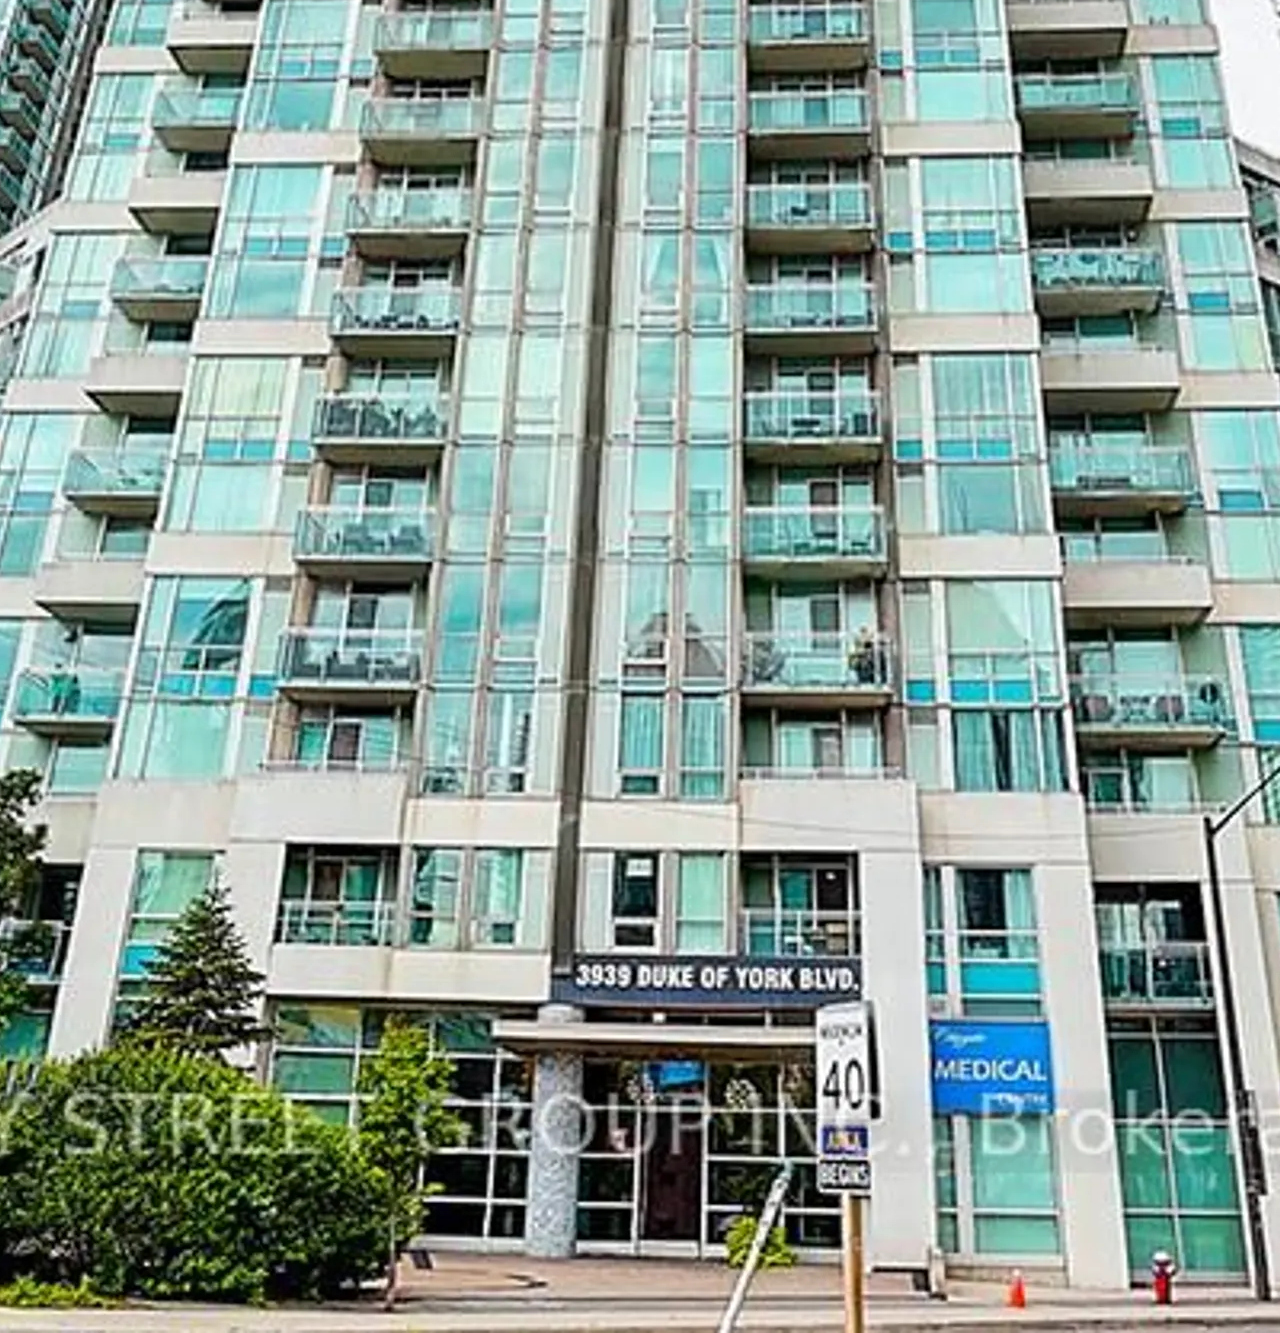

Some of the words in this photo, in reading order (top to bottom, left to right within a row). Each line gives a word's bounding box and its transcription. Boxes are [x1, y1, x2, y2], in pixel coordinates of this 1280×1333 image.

[574, 964, 631, 988] 3939
[637, 965, 693, 989] DUKE
[700, 965, 732, 989] OF
[736, 966, 794, 990] YORK
[799, 967, 860, 991] BLVD.
[822, 1057, 866, 1110] 40
[934, 1058, 1048, 1083] MEDICAL
